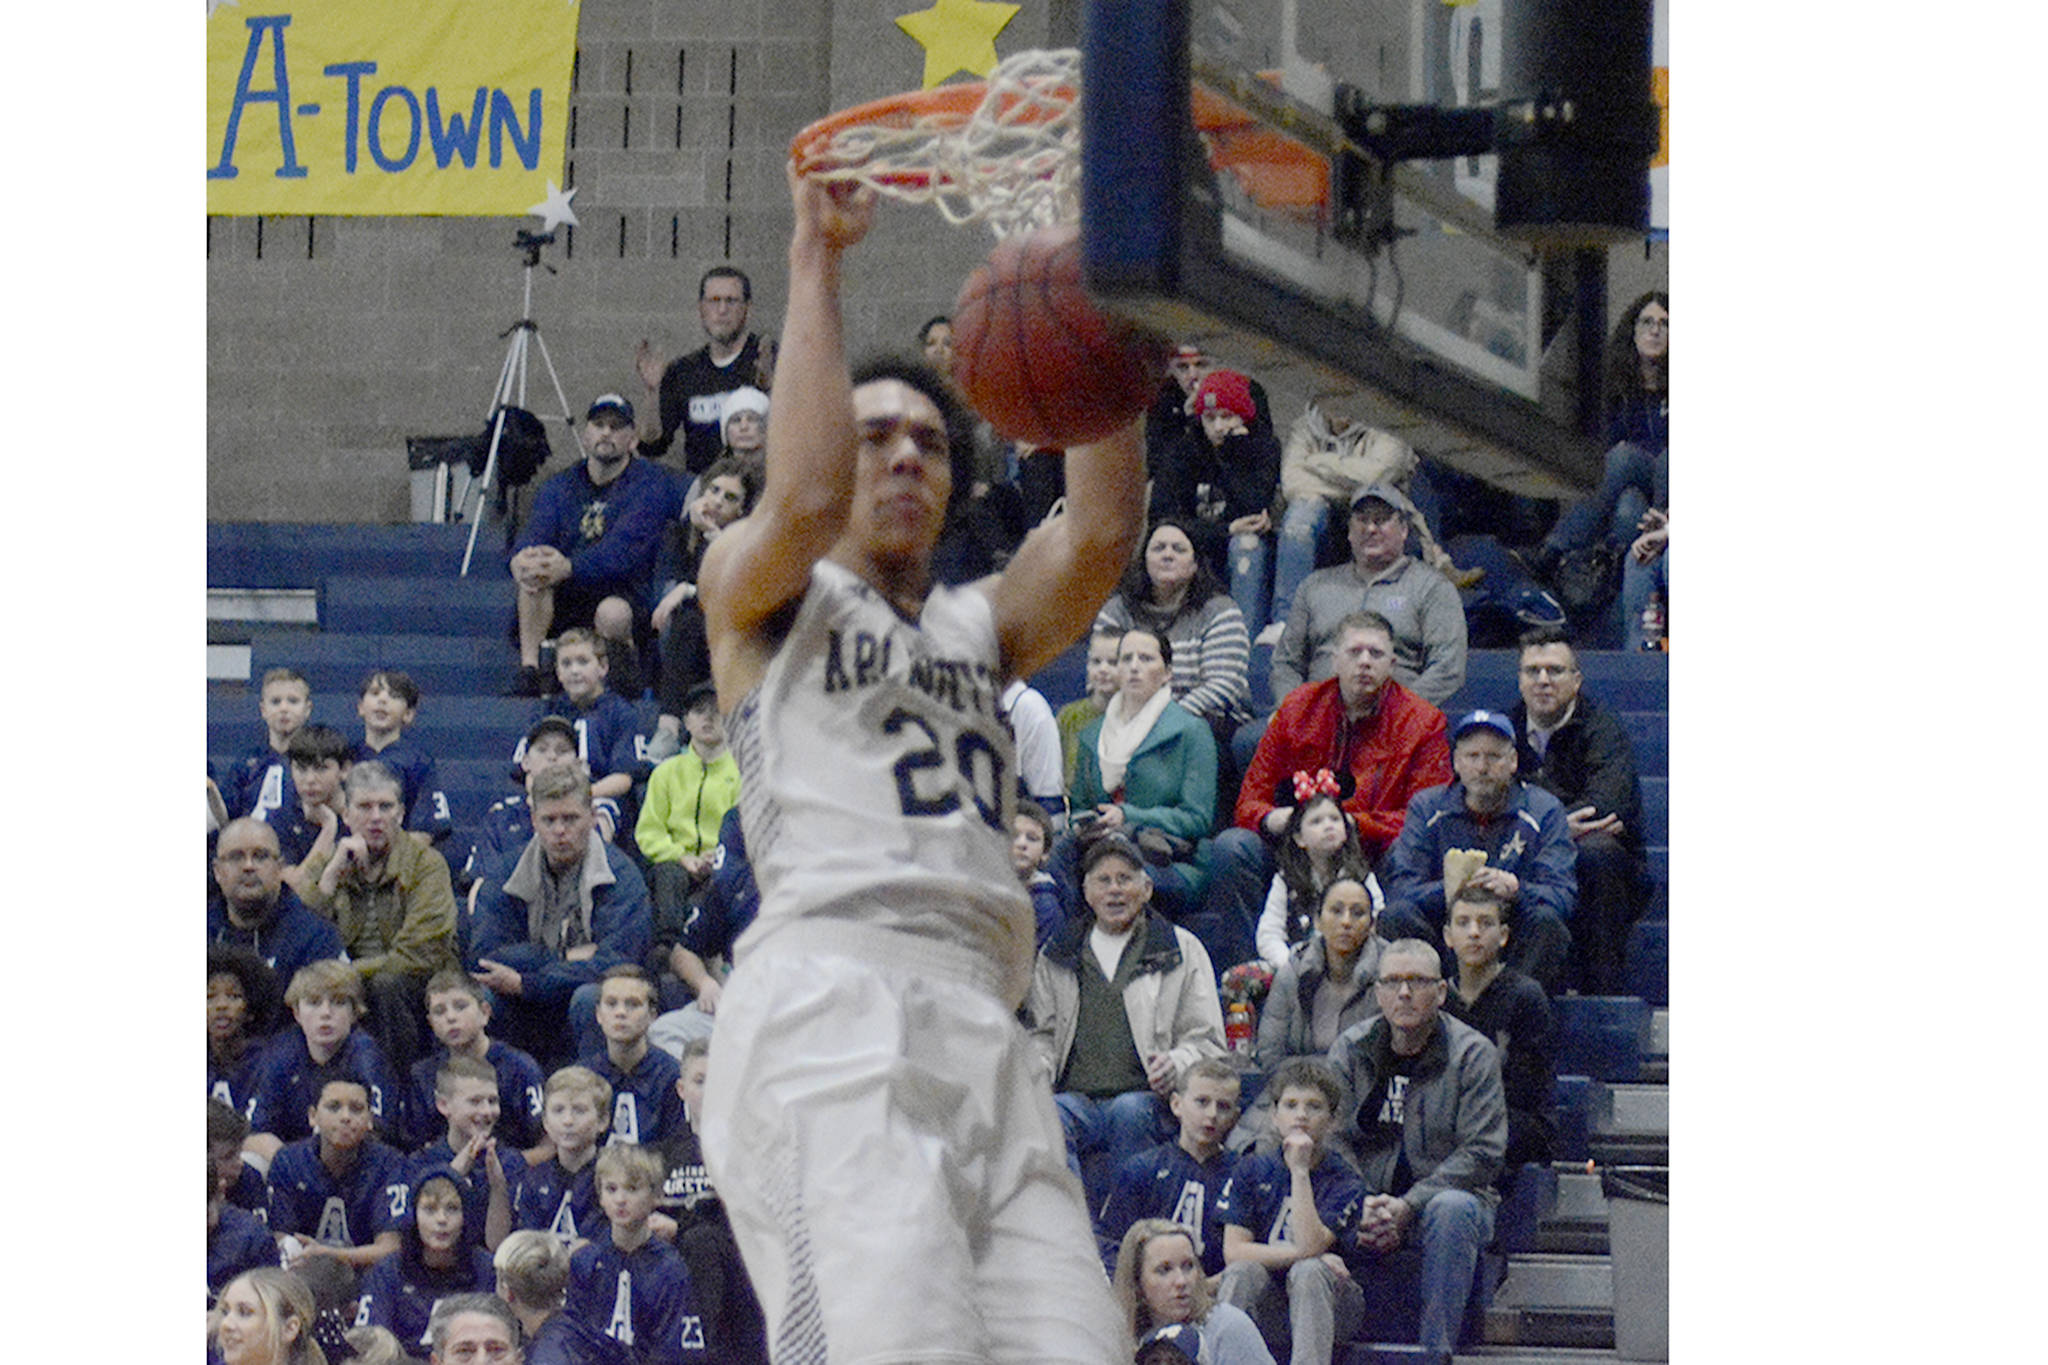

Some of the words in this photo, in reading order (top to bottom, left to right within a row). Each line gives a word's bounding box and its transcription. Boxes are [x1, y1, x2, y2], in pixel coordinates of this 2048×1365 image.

[206, 14, 542, 179] A-TOWN
[883, 706, 1007, 833] 20
[680, 1315, 705, 1349] 23
